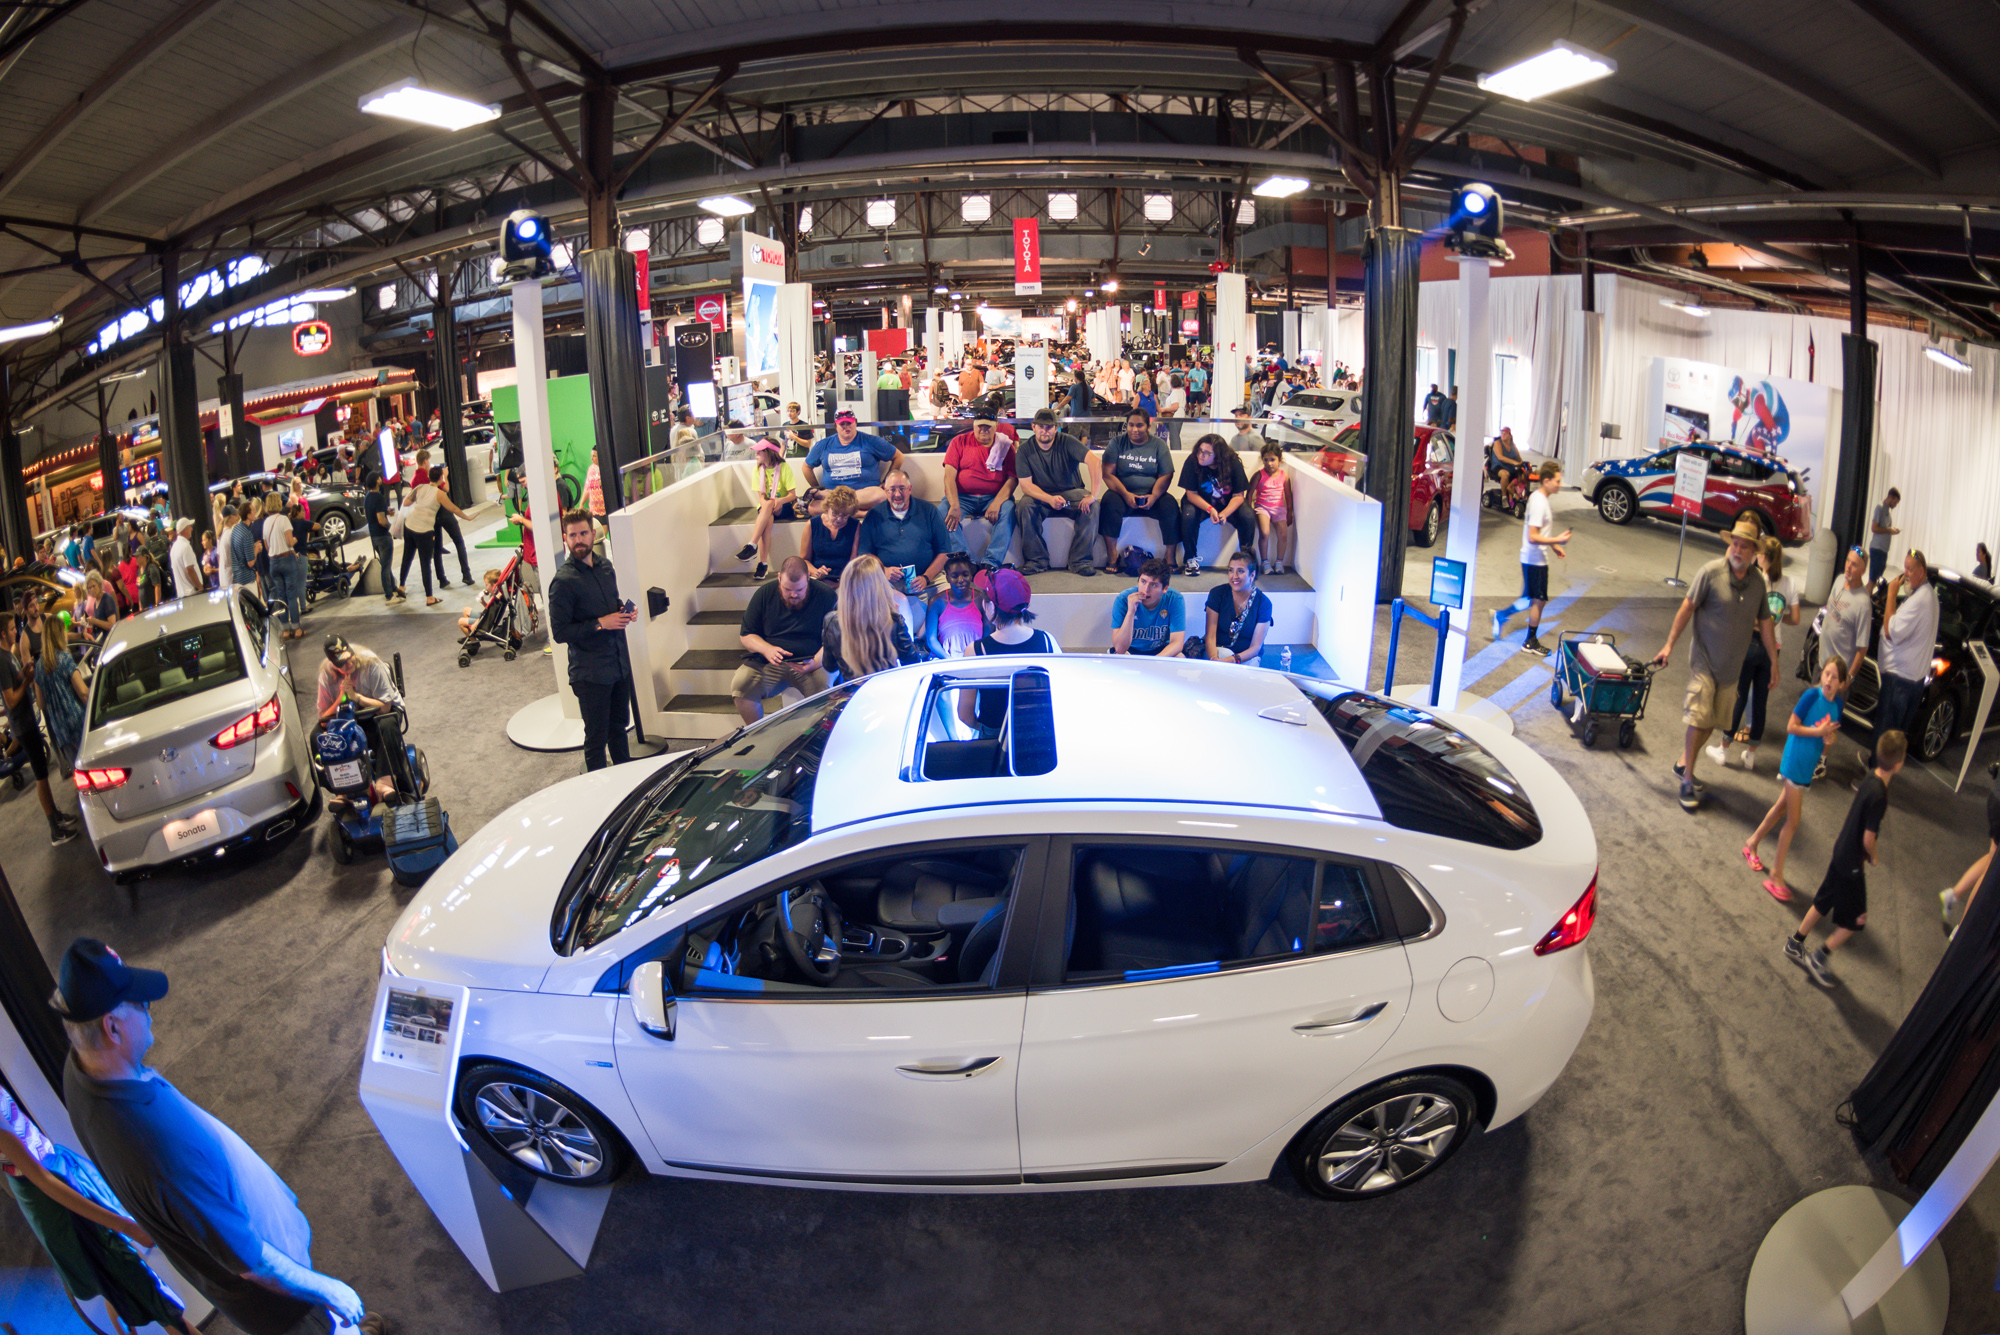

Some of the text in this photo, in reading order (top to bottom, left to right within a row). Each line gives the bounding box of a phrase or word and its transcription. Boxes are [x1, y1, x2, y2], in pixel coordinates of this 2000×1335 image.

[761, 248, 784, 266] TOYOTA
[1022, 230, 1032, 272] TOYOTA
[1184, 321, 1198, 330] dish
[1126, 453, 1135, 461] do
[321, 736, 343, 749] Ford
[177, 824, 206, 839] Sonata
